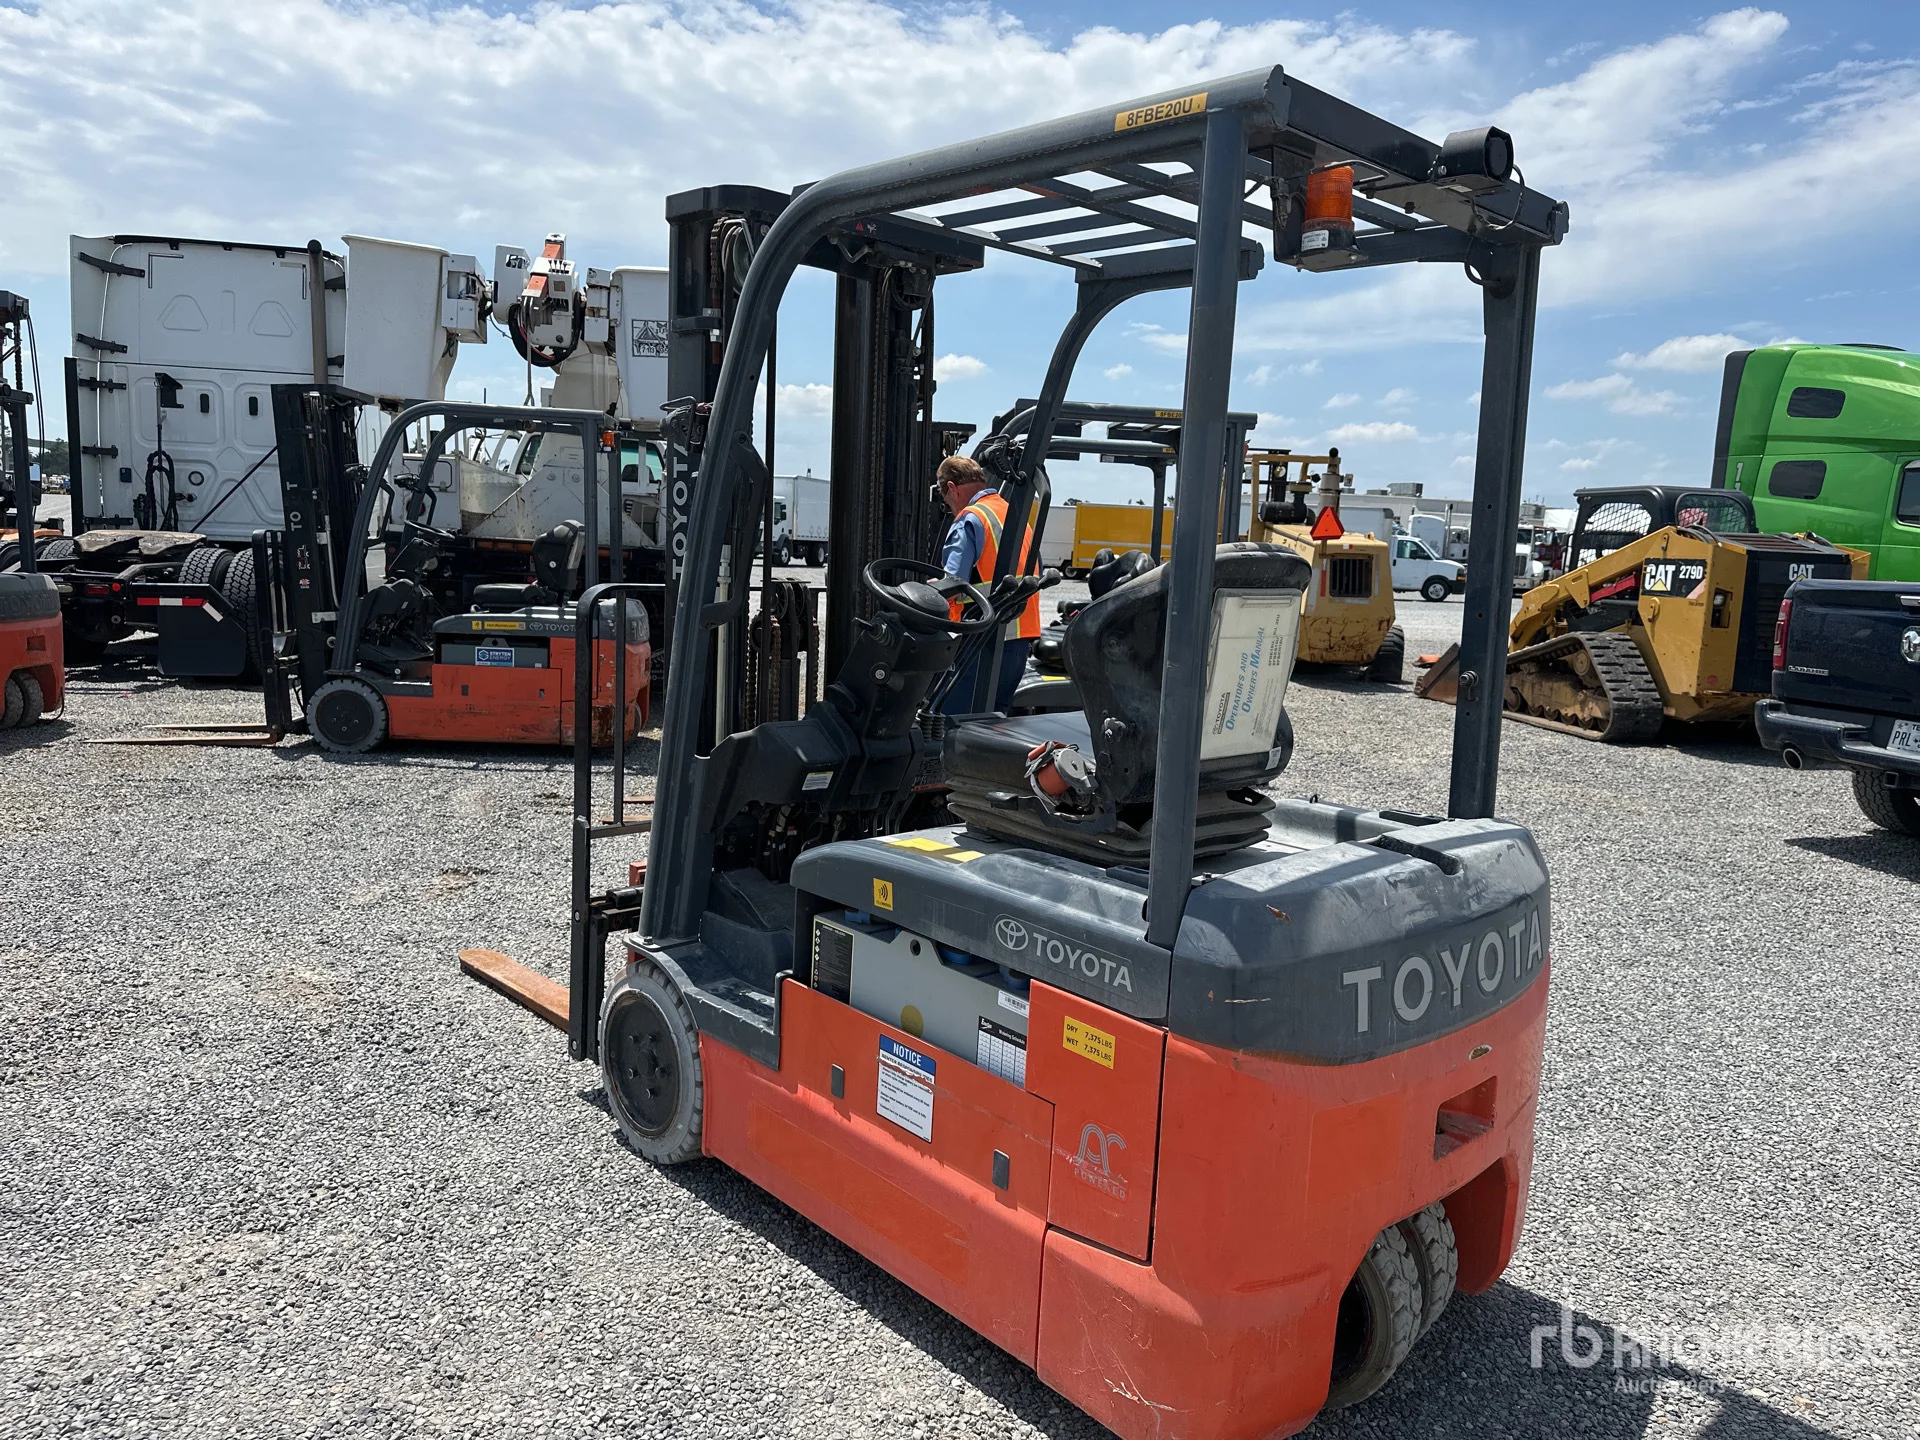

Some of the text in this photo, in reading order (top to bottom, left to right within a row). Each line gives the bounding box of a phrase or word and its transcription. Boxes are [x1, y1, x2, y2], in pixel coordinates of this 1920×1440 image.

[1126, 98, 1193, 127] 8FBE20U
[1645, 564, 1703, 591] CAT 279D
[1789, 563, 1814, 581] CAT
[544, 623, 577, 631] TOYOT
[1242, 671, 1258, 713] OWNER'S
[1251, 626, 1265, 669] MANUAL
[1215, 692, 1226, 723] TOYOTA
[1892, 731, 1912, 747] PRL
[1033, 932, 1132, 993] TOYOTA
[1343, 905, 1543, 1033] TOYOTA
[1066, 1024, 1112, 1049] DRY 7,375 LBS
[1066, 1036, 1112, 1062] WET 7,375 LBS
[893, 1042, 922, 1067] NOTICE
[1074, 1167, 1126, 1199] POWERED
